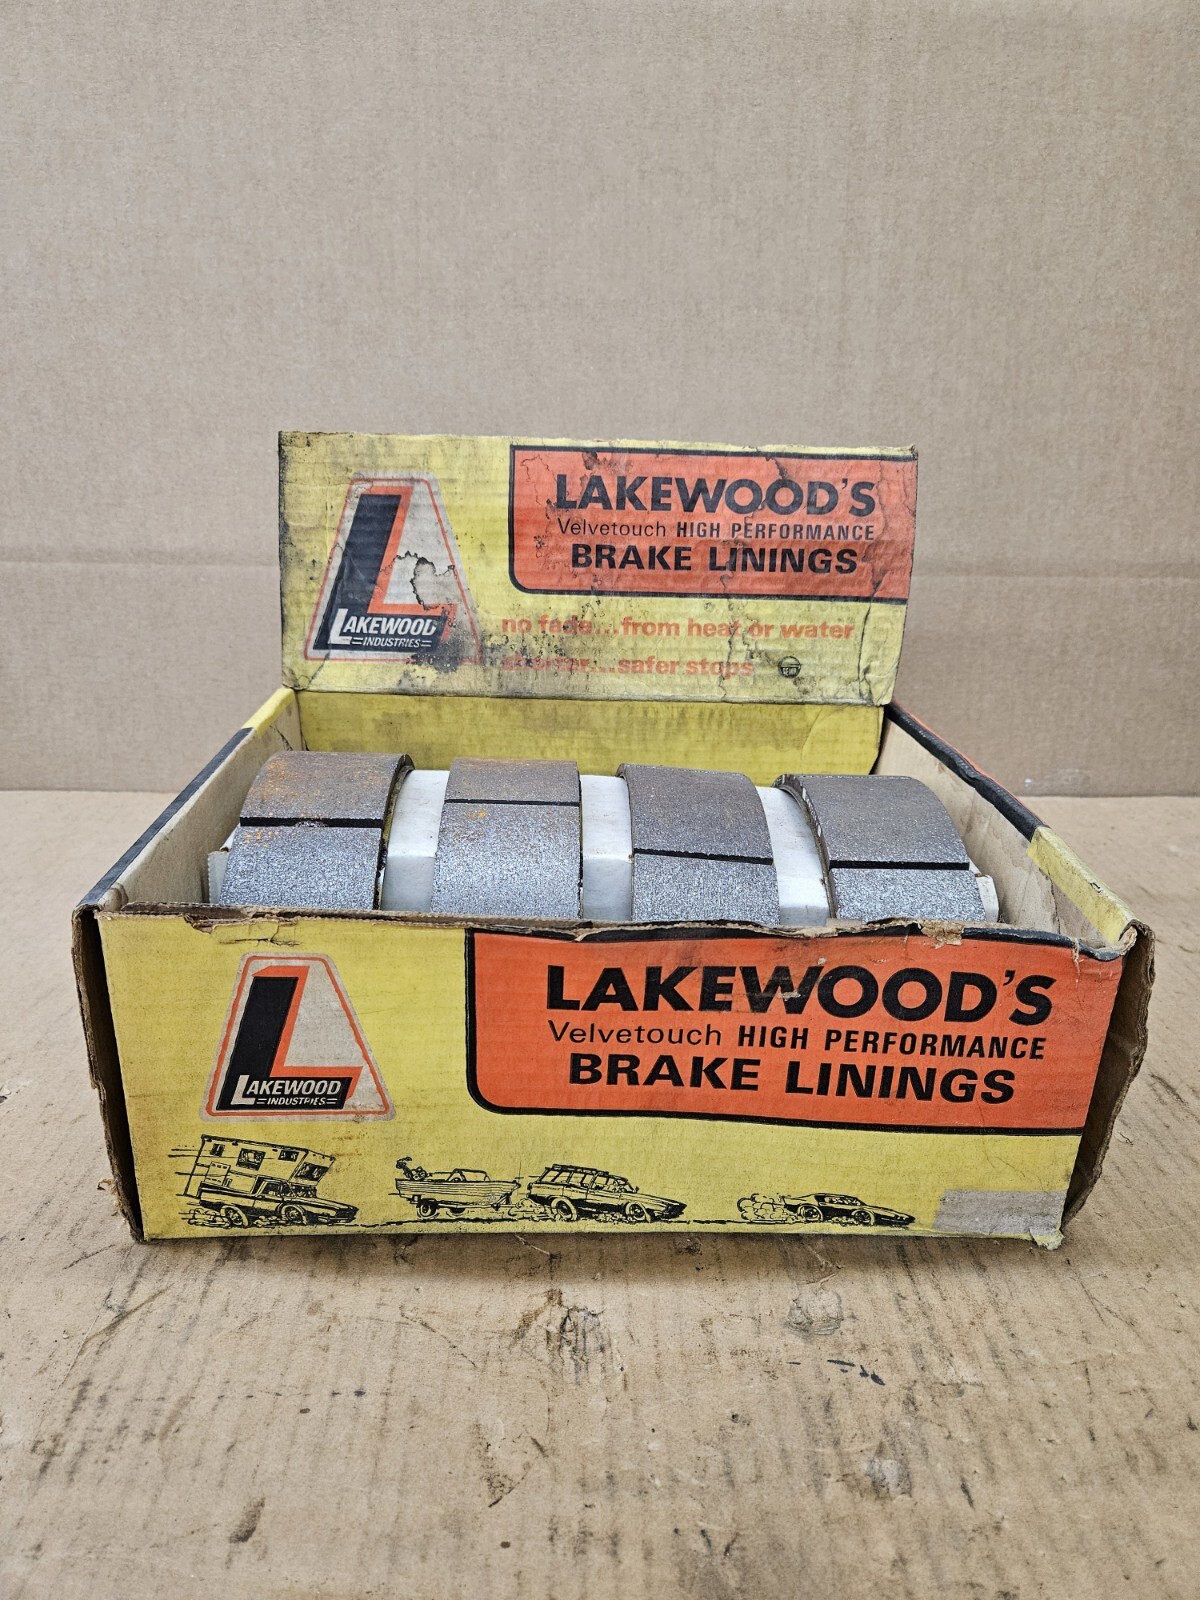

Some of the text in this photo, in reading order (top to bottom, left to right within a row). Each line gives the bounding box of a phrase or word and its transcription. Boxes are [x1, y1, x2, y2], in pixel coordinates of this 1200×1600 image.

[556, 473, 876, 517] LAKEWOOD'S
[557, 517, 874, 541] Velvetouch HIGH PERFORMANCE
[571, 543, 858, 574] BRAKE LININGS
[328, 608, 437, 645] LAKEWOOD
[362, 636, 421, 648] INDUSTRIES
[501, 617, 532, 634] no
[687, 618, 742, 638] heat
[748, 622, 775, 639] or
[780, 620, 855, 640] water
[686, 657, 752, 680] stops
[547, 964, 1057, 1026] LAKEWOOD'S
[548, 1019, 1047, 1060] Velvetouch HIGH PERFORMANCE
[230, 1074, 342, 1105] LAKEWOOD
[569, 1053, 1016, 1105] BRAKE LININGS
[267, 1097, 326, 1106] INDUSTRIES
